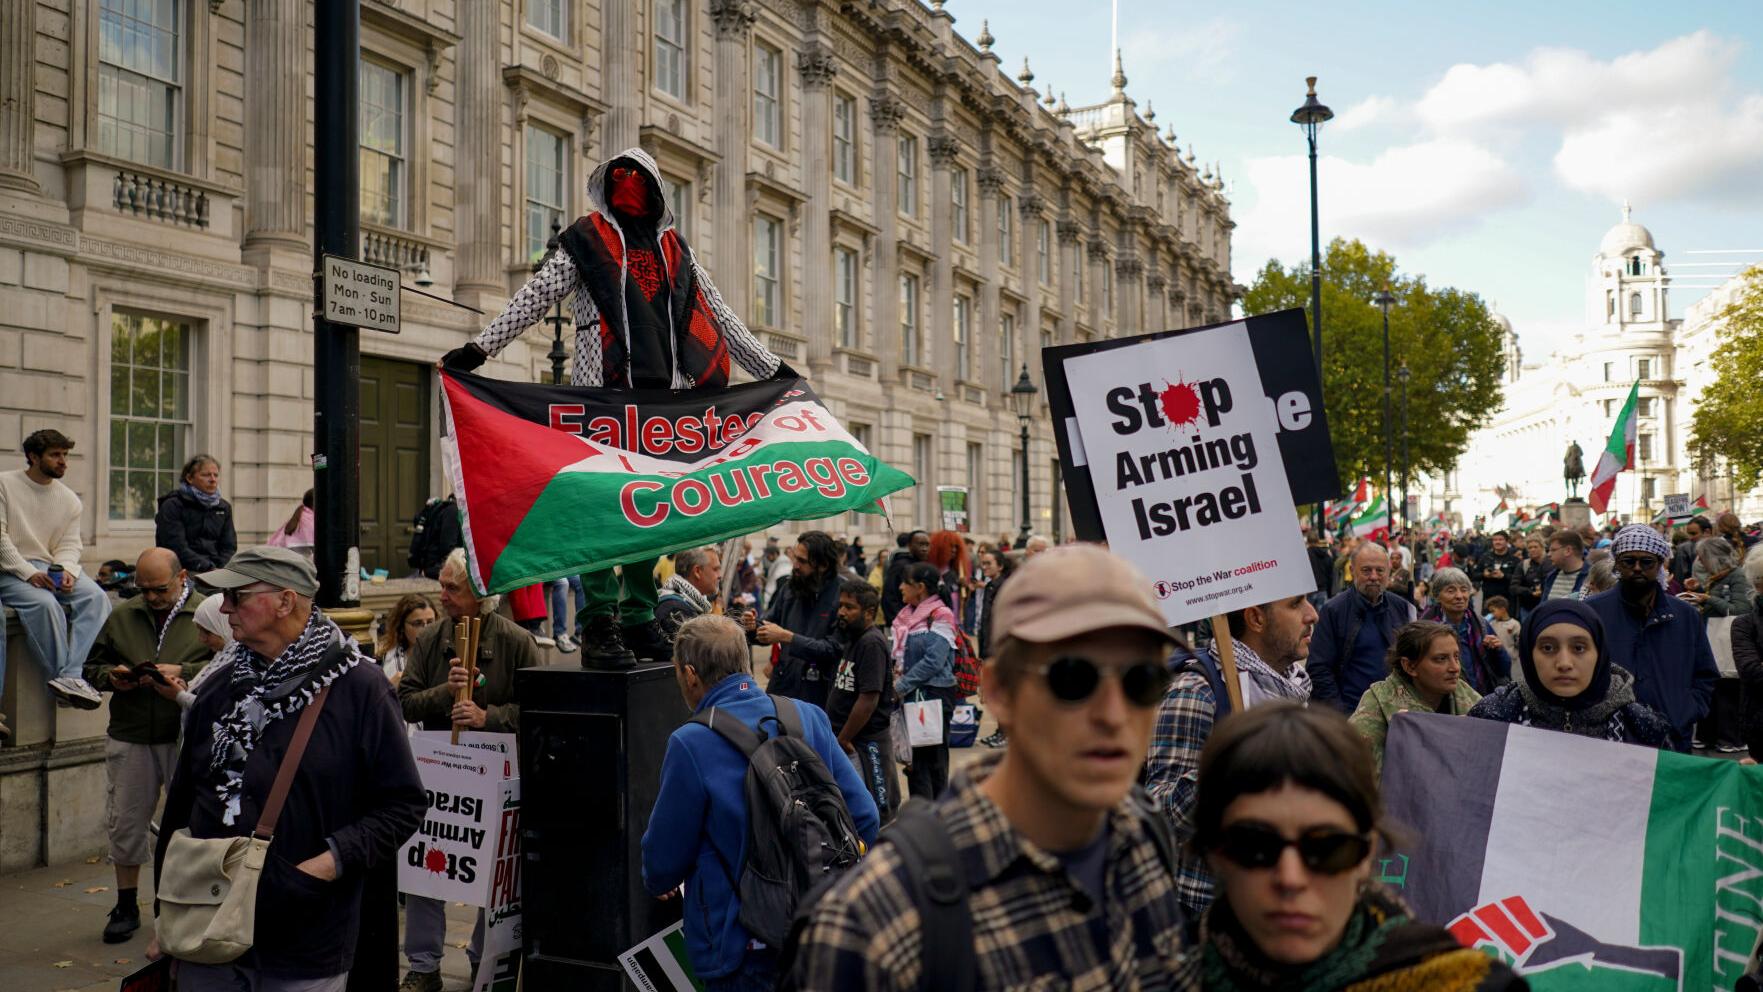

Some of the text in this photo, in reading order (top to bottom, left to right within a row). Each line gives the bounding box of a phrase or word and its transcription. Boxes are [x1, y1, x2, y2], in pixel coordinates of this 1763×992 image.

[332, 265, 393, 290] No loading
[334, 283, 359, 299] Mon
[370, 291, 391, 305] Sun
[772, 409, 826, 432] of
[1116, 432, 1258, 490] Arming
[620, 457, 871, 529] Courage
[1131, 473, 1262, 541] Israel
[1171, 559, 1278, 592] Stop the War coalition
[1186, 582, 1254, 606] www.stopwar.org.uk
[418, 820, 486, 850] Armin
[1713, 806, 1763, 992] TINE
[626, 956, 656, 992] ampaign
